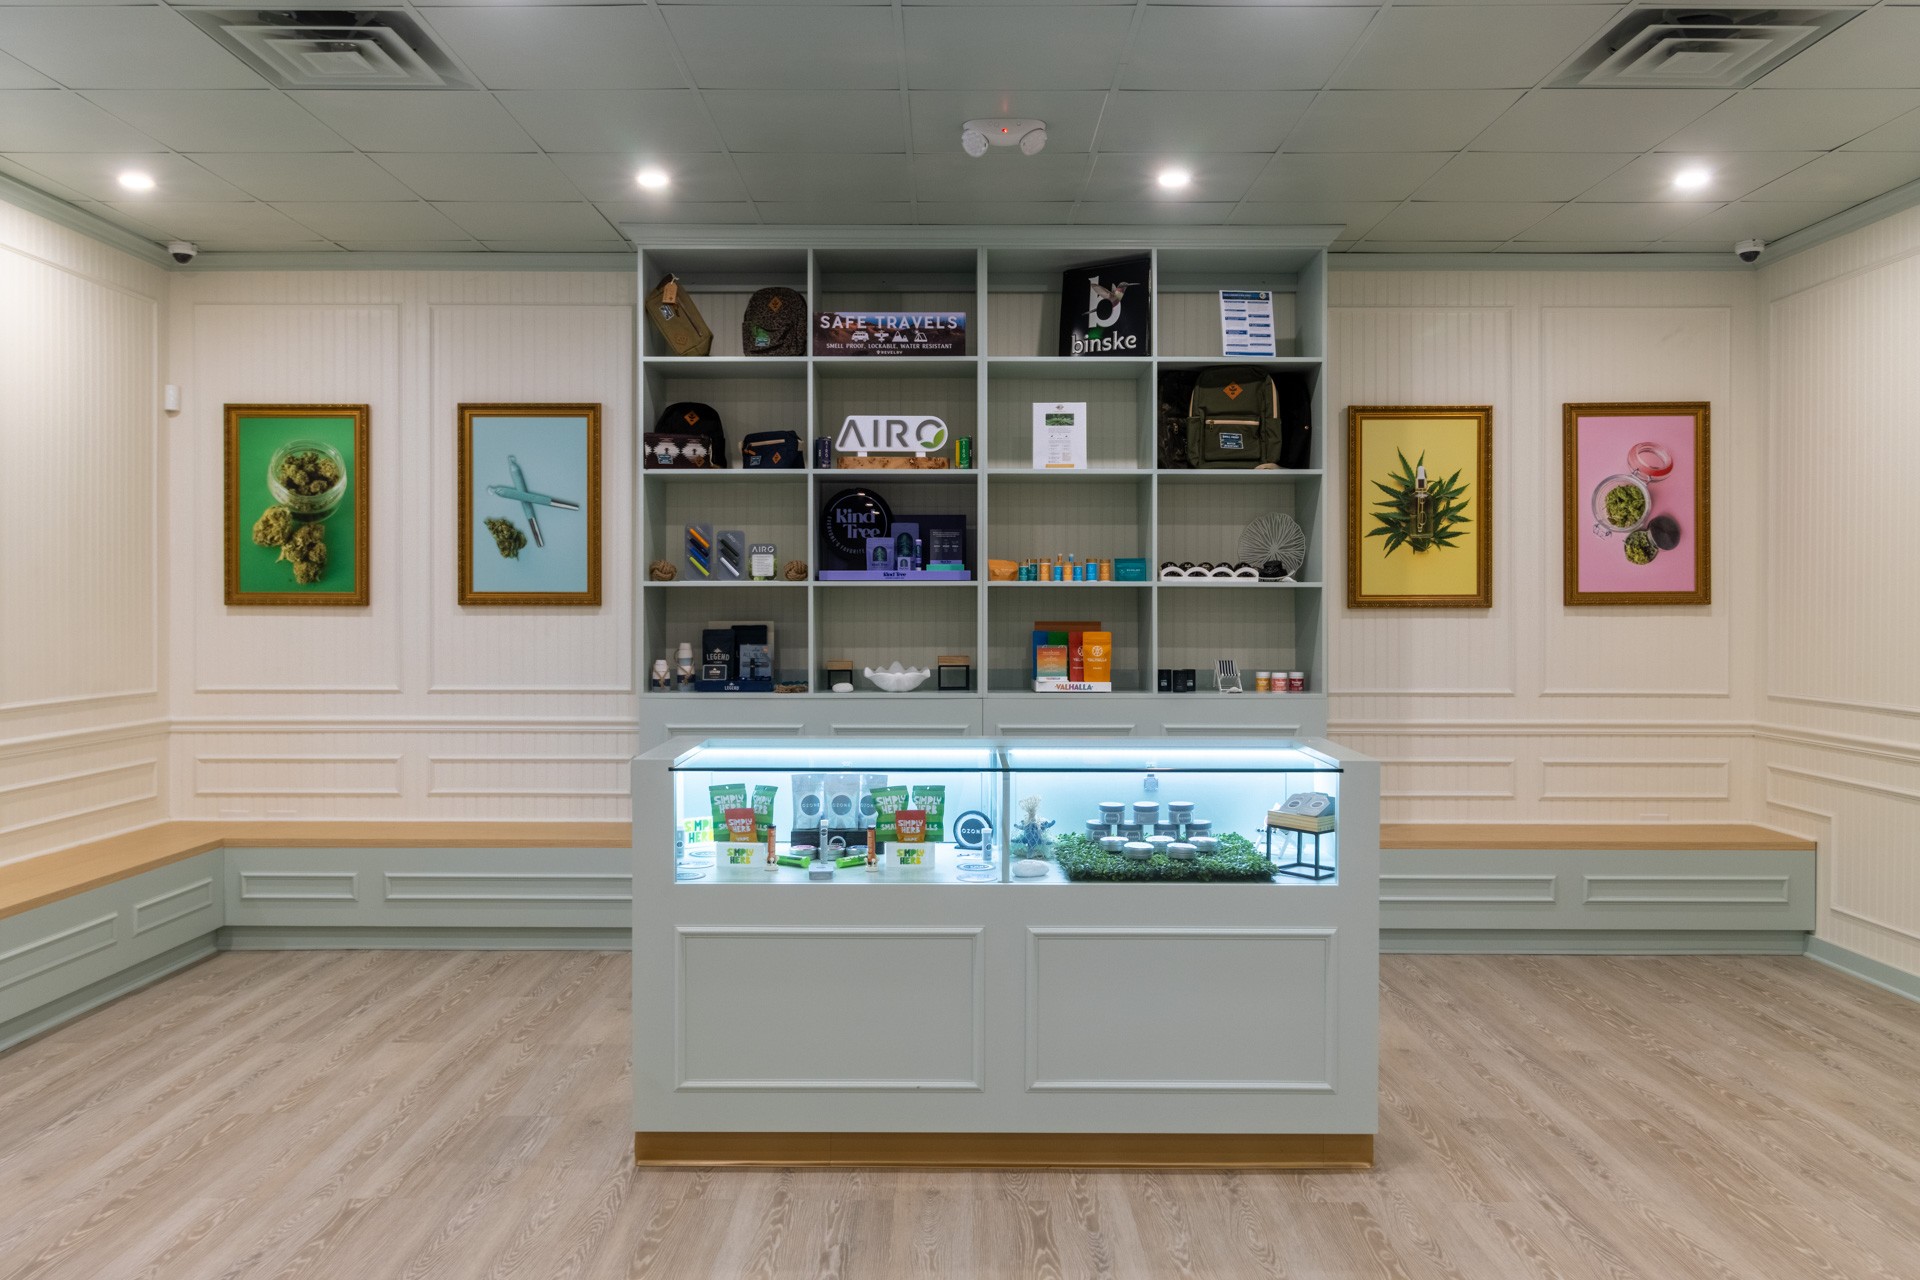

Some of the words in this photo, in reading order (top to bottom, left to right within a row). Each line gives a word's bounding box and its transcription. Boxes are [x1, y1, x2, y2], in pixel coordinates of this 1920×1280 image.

[820, 315, 867, 329] SAFE
[876, 315, 958, 329] TRAVELS
[1071, 331, 1137, 354] binske
[838, 419, 945, 449] AIRO
[836, 508, 876, 523] Kind
[842, 523, 881, 538] Tree
[706, 653, 730, 661] LEGEND
[713, 794, 745, 806] SIMPLY
[875, 794, 906, 806] SIMPLY
[914, 795, 942, 805] SIMPLY
[728, 818, 753, 826] SIMPLY
[732, 825, 751, 833] HERB
[901, 826, 921, 834] HERB
[727, 848, 754, 857] SIMPLY
[897, 849, 925, 857] SIMPLY
[730, 856, 751, 865] HERB
[900, 857, 922, 865] HERB
